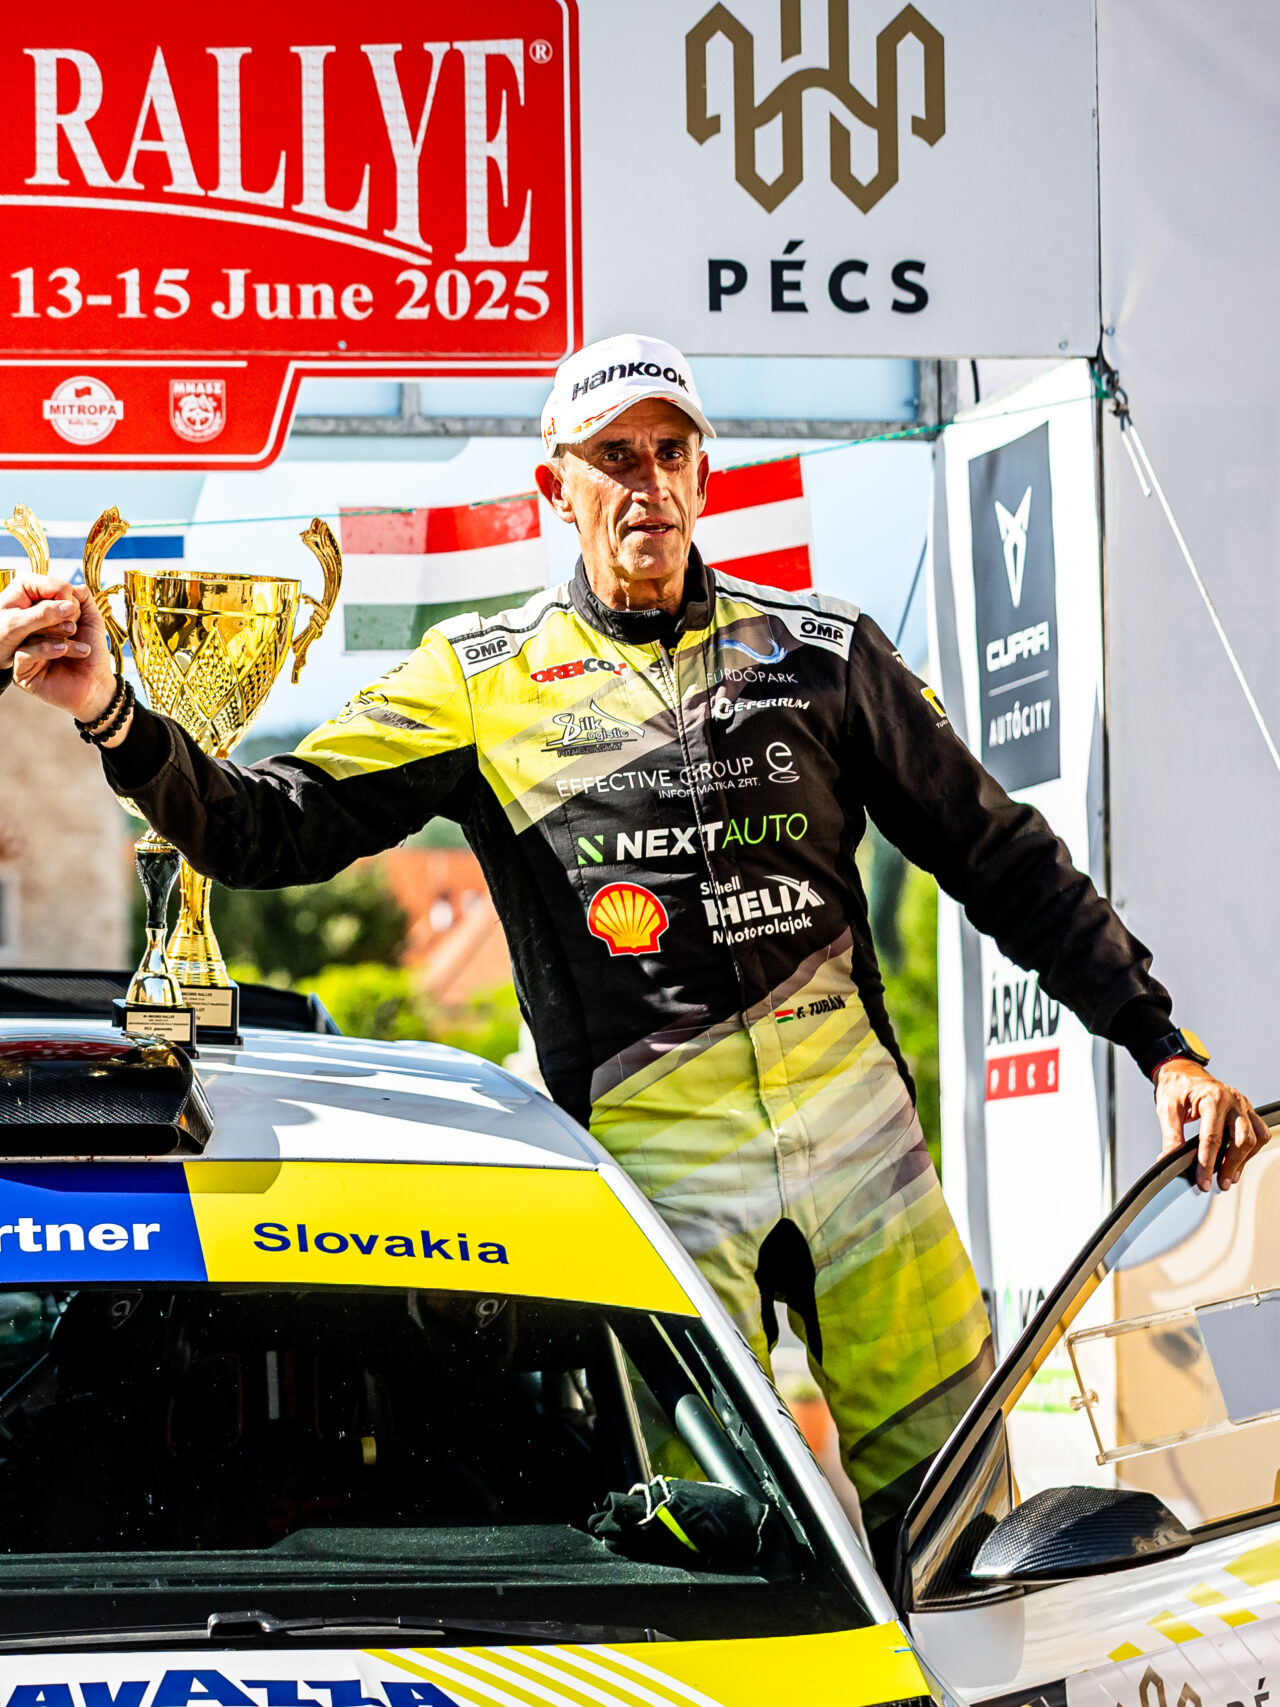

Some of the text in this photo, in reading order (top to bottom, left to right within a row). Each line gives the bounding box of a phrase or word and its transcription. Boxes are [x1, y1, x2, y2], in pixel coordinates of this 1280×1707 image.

[22, 38, 533, 263] RALLYE
[10, 267, 552, 321] 13-15 June 2025
[709, 239, 930, 314] PÉCS
[49, 404, 117, 416] MITROPA
[465, 639, 508, 660] OMP
[800, 620, 844, 641] OMP
[986, 620, 1050, 673] CUPRA
[989, 698, 1051, 748] AUTÓCITY
[556, 757, 754, 798] EFFECTIVE GROUP
[738, 776, 762, 789] ZRT.
[700, 875, 741, 896] Shell
[701, 876, 826, 927] HELIX
[712, 913, 813, 946] Motorolajok
[253, 1222, 510, 1265] Slovakia
